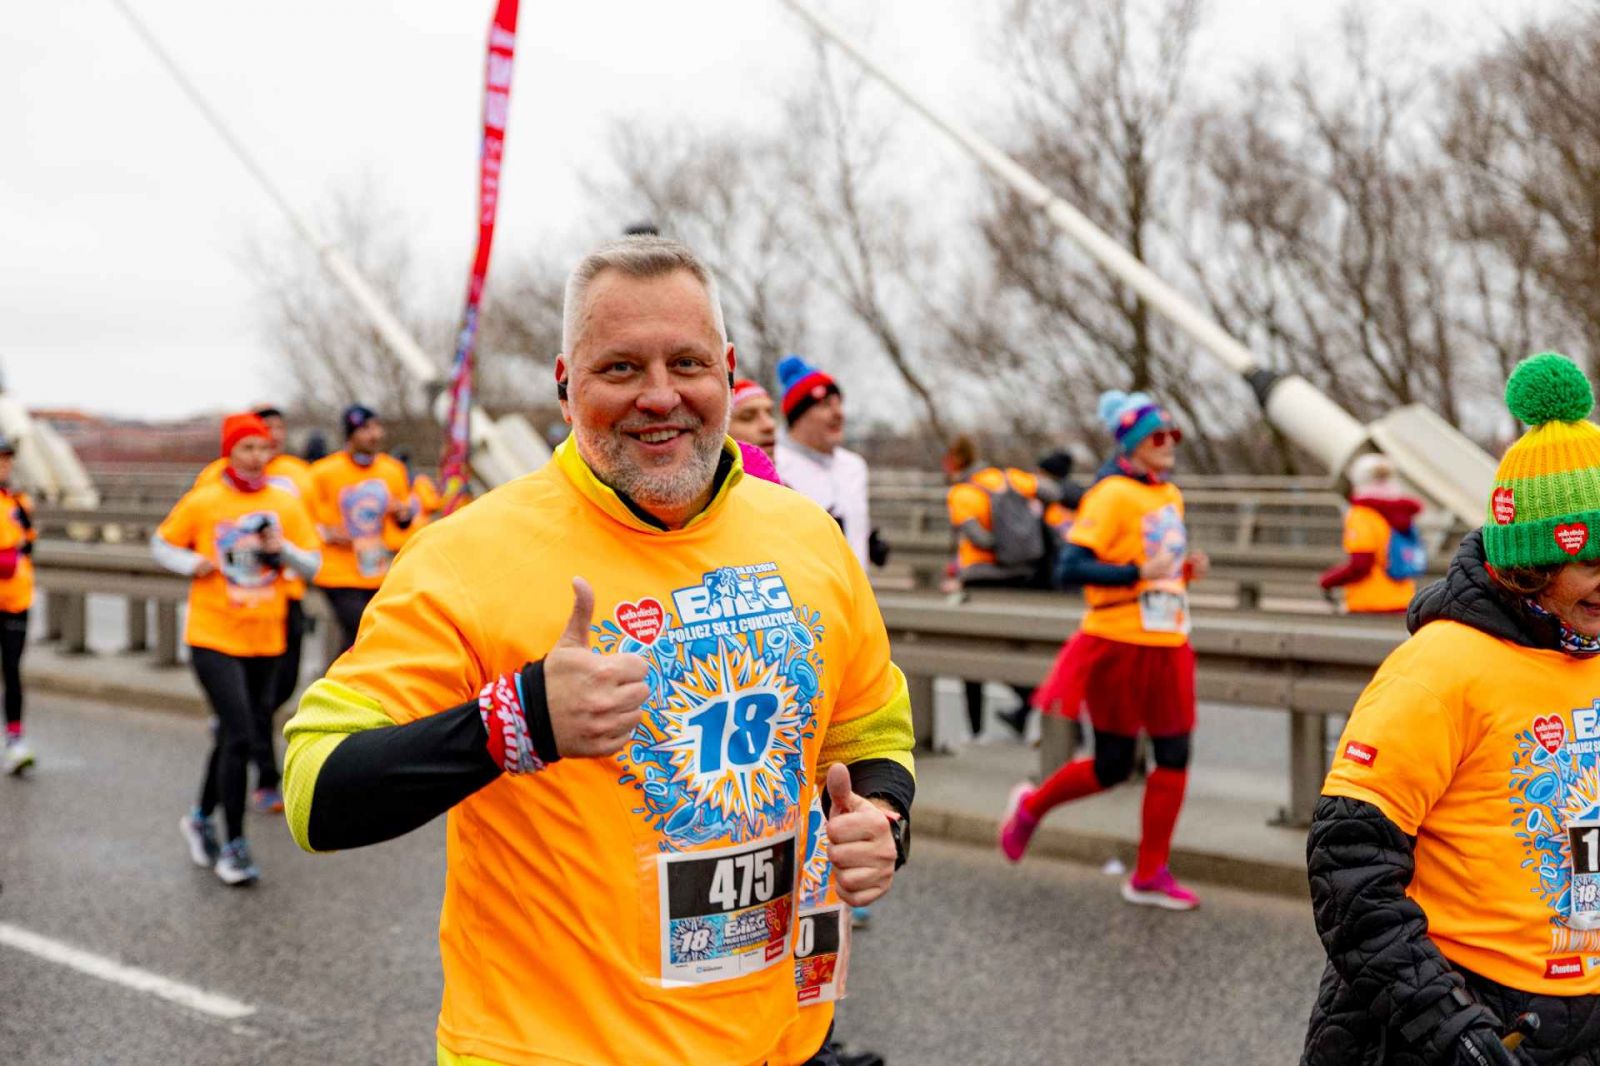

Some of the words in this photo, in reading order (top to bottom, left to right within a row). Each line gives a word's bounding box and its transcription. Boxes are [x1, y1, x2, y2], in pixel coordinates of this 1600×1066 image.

[668, 625, 712, 644] POLICZ
[731, 621, 739, 634] Z
[688, 694, 778, 773] 18
[1566, 740, 1593, 755] POLICZ
[709, 848, 775, 910] 475
[1578, 884, 1596, 902] 18
[680, 928, 711, 952] 18
